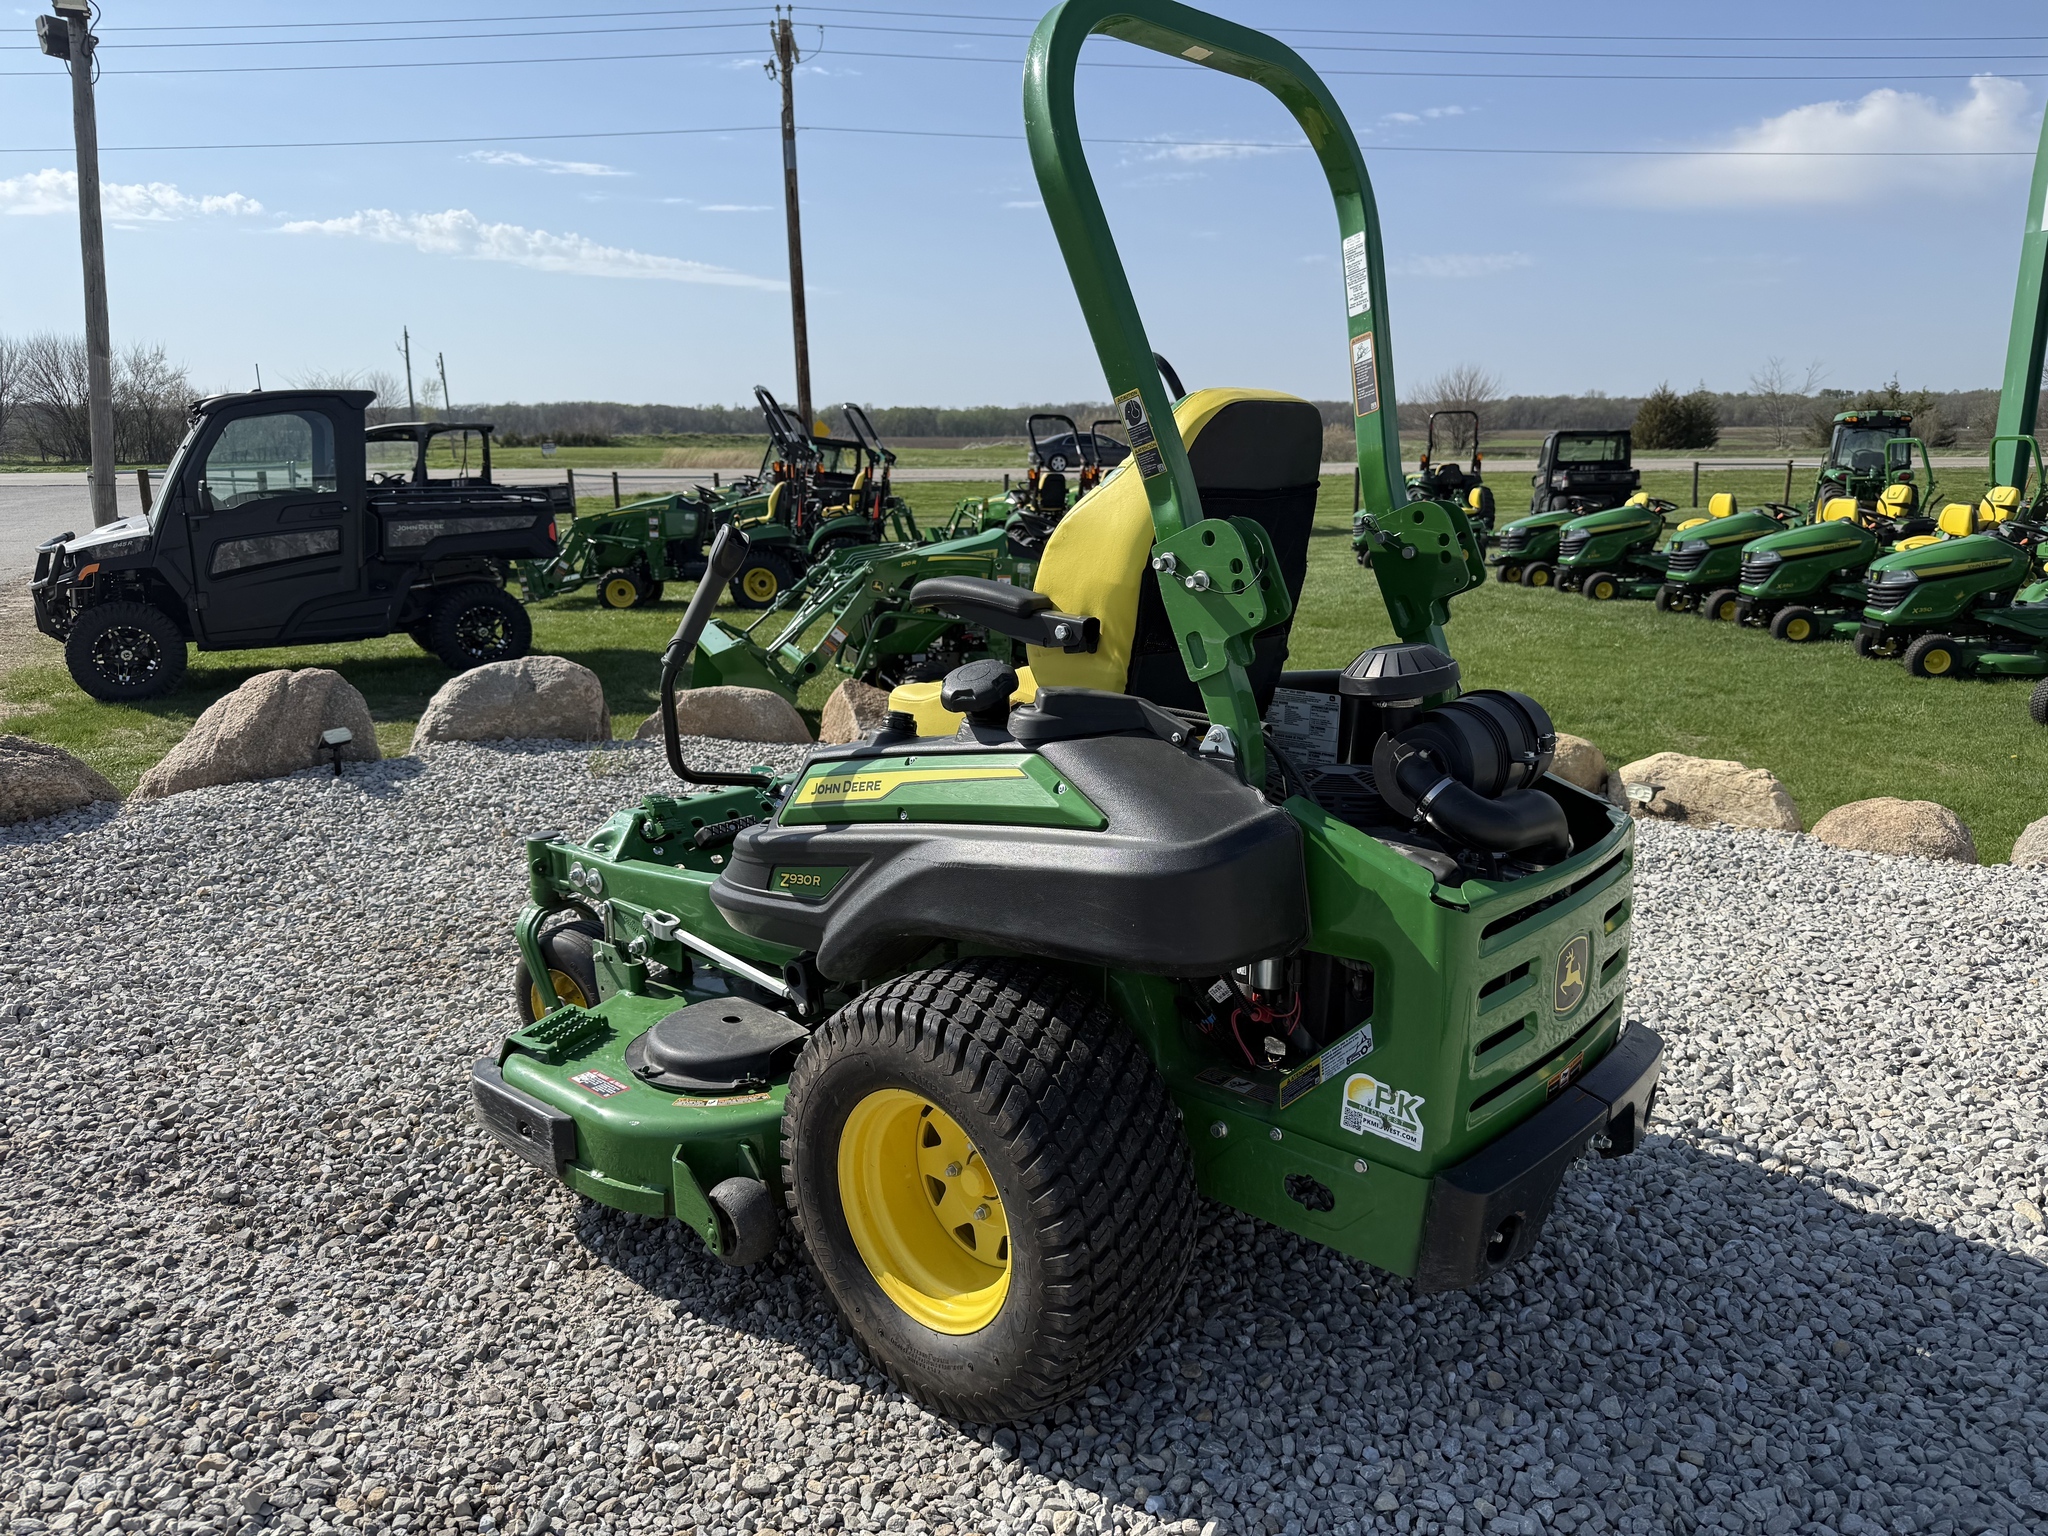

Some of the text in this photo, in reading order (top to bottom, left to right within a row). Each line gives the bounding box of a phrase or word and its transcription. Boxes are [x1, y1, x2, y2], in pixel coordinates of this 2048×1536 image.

[418, 523, 445, 531] DEERE
[811, 780, 882, 796] JOHN DEERE
